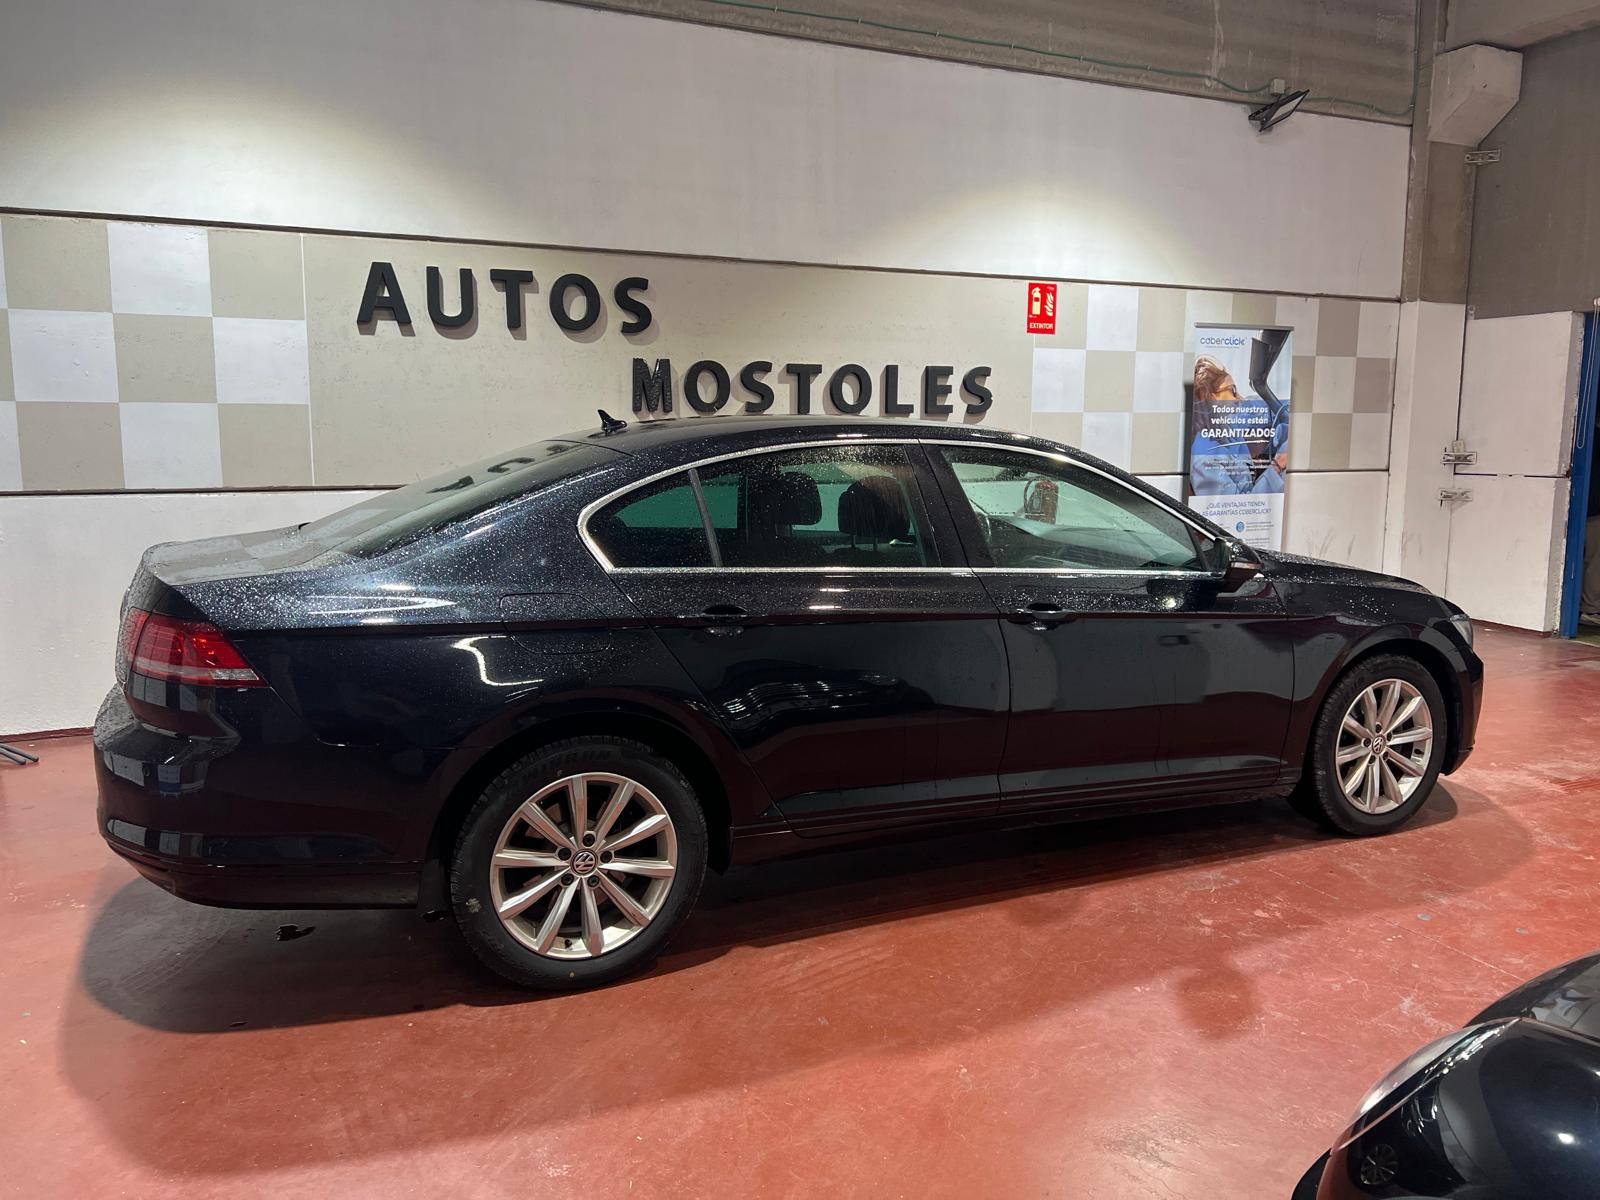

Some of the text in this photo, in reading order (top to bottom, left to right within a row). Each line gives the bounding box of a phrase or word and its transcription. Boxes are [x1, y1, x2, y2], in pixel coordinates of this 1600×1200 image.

[357, 262, 652, 334] AUTOS
[632, 357, 992, 415] MOSTOLES
[1212, 405, 1268, 413] Todos nuestros
[1201, 428, 1275, 438] GARANTIZADOS
[1221, 501, 1246, 509] VENTAJAS
